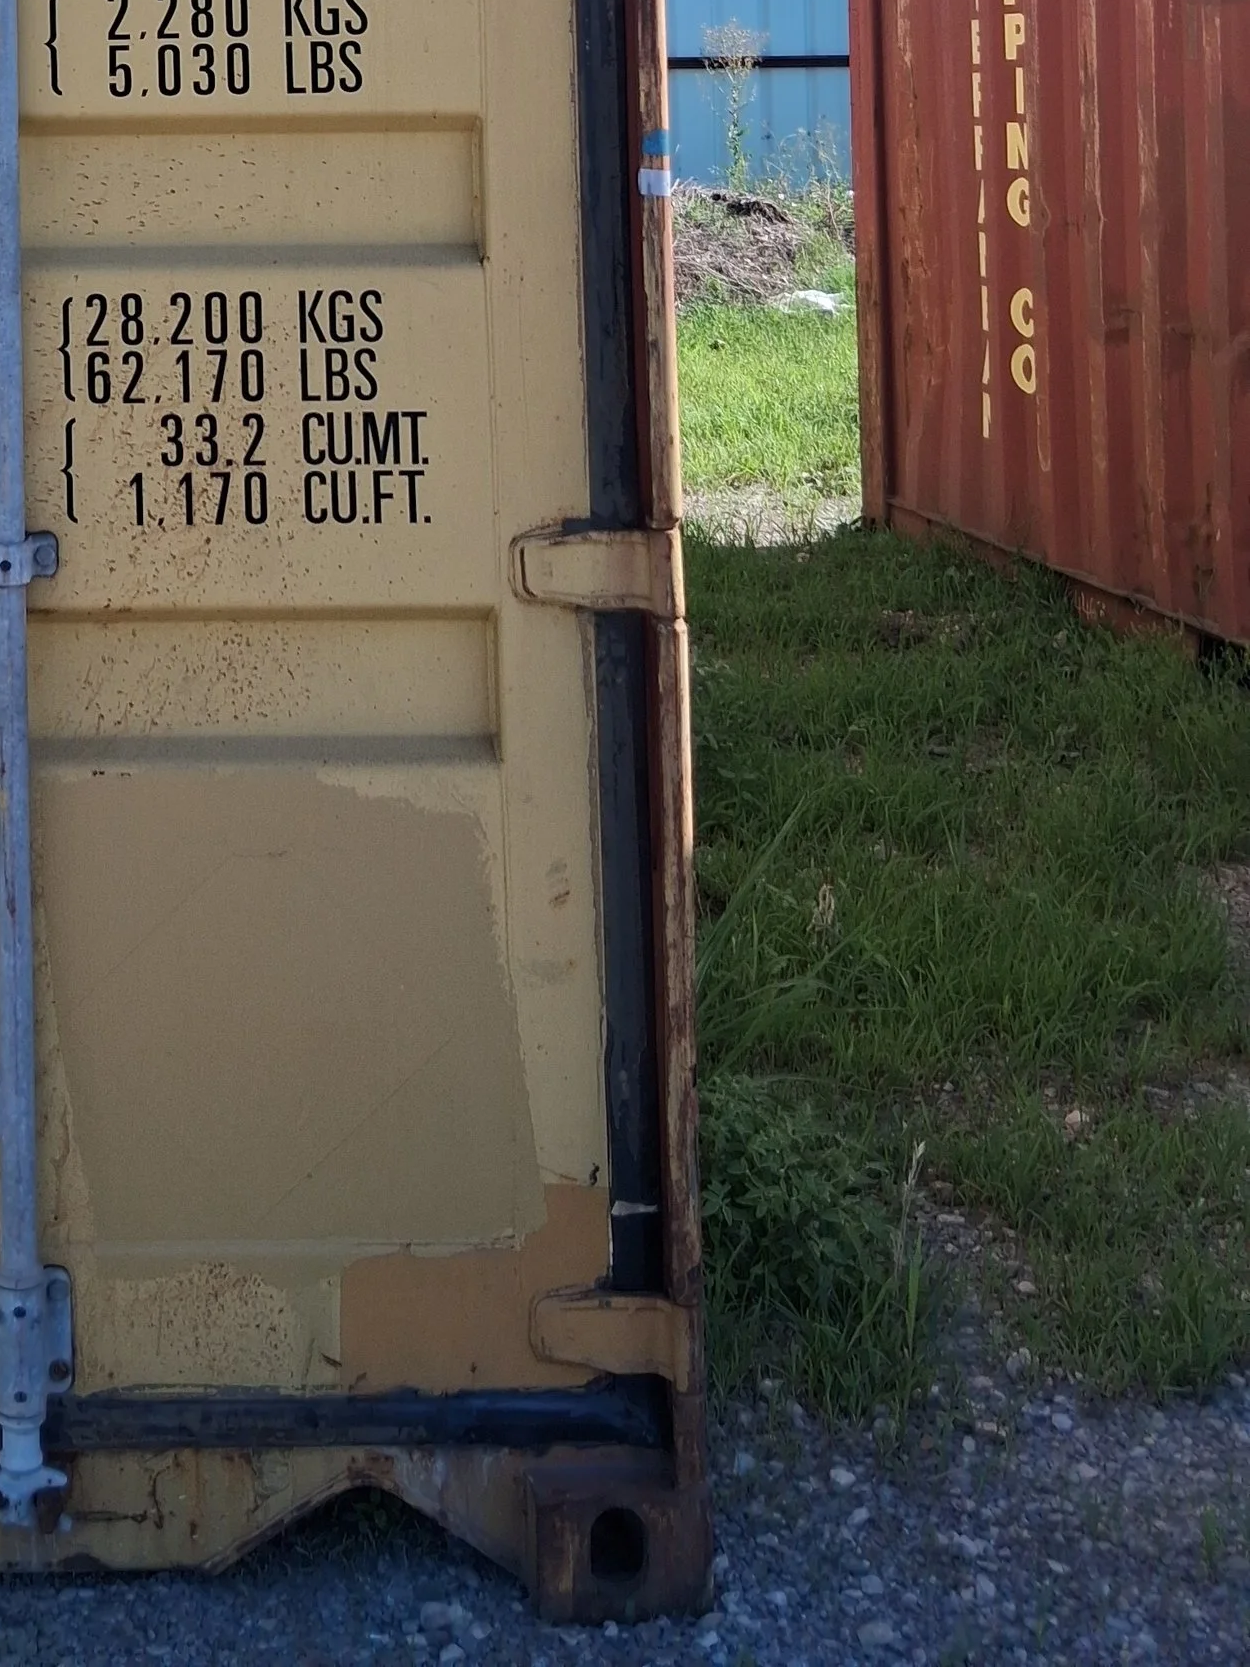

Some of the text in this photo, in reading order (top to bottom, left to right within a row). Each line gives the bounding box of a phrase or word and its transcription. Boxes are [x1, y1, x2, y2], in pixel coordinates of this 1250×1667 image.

[108, 40, 364, 98] 5,030 LBS
[85, 289, 384, 347] 28,200 KGS
[1009, 287, 1037, 395] CO
[87, 347, 379, 405] 62,170 LBS
[160, 411, 430, 467] 33.2 CU.MT.
[129, 469, 433, 527] 1,170 CU.FT.
